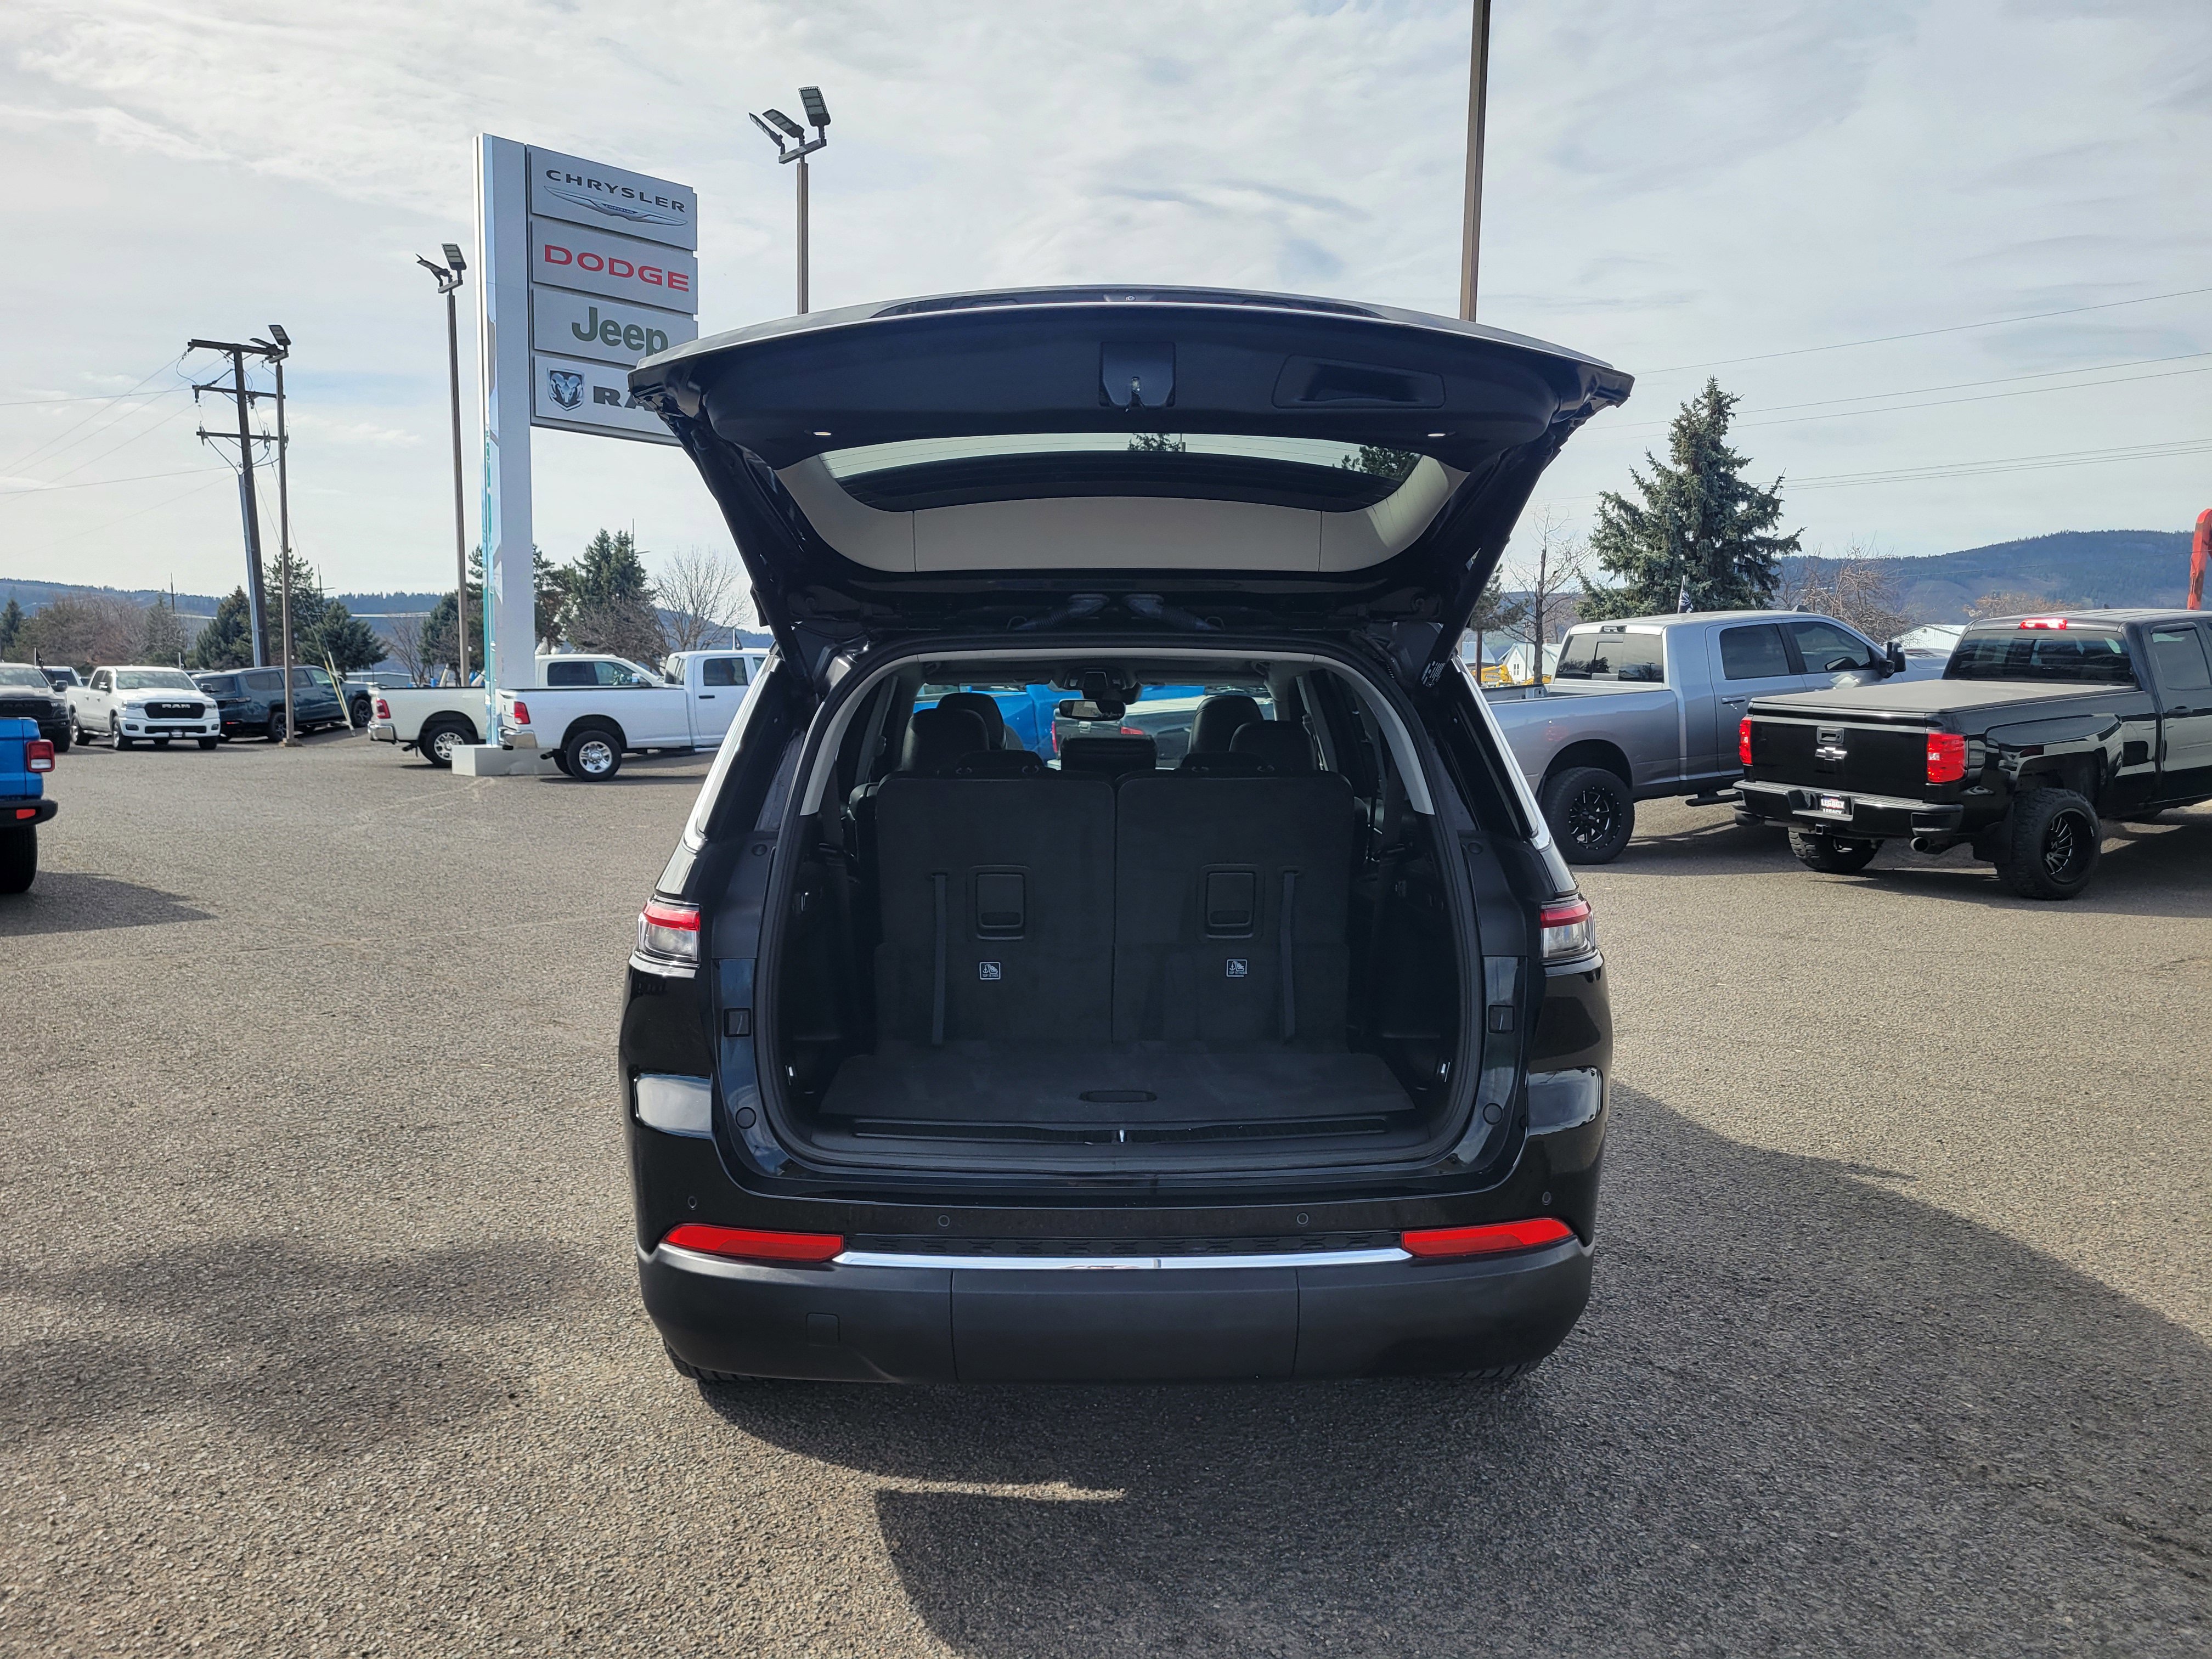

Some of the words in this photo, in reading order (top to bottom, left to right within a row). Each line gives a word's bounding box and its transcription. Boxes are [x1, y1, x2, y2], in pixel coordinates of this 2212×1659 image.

[546, 169, 685, 213] CHRYSLER
[544, 244, 689, 292] DODGE
[571, 306, 668, 356] Jeep
[593, 386, 656, 413] RA
[1821, 798, 1845, 809] LEGACY
